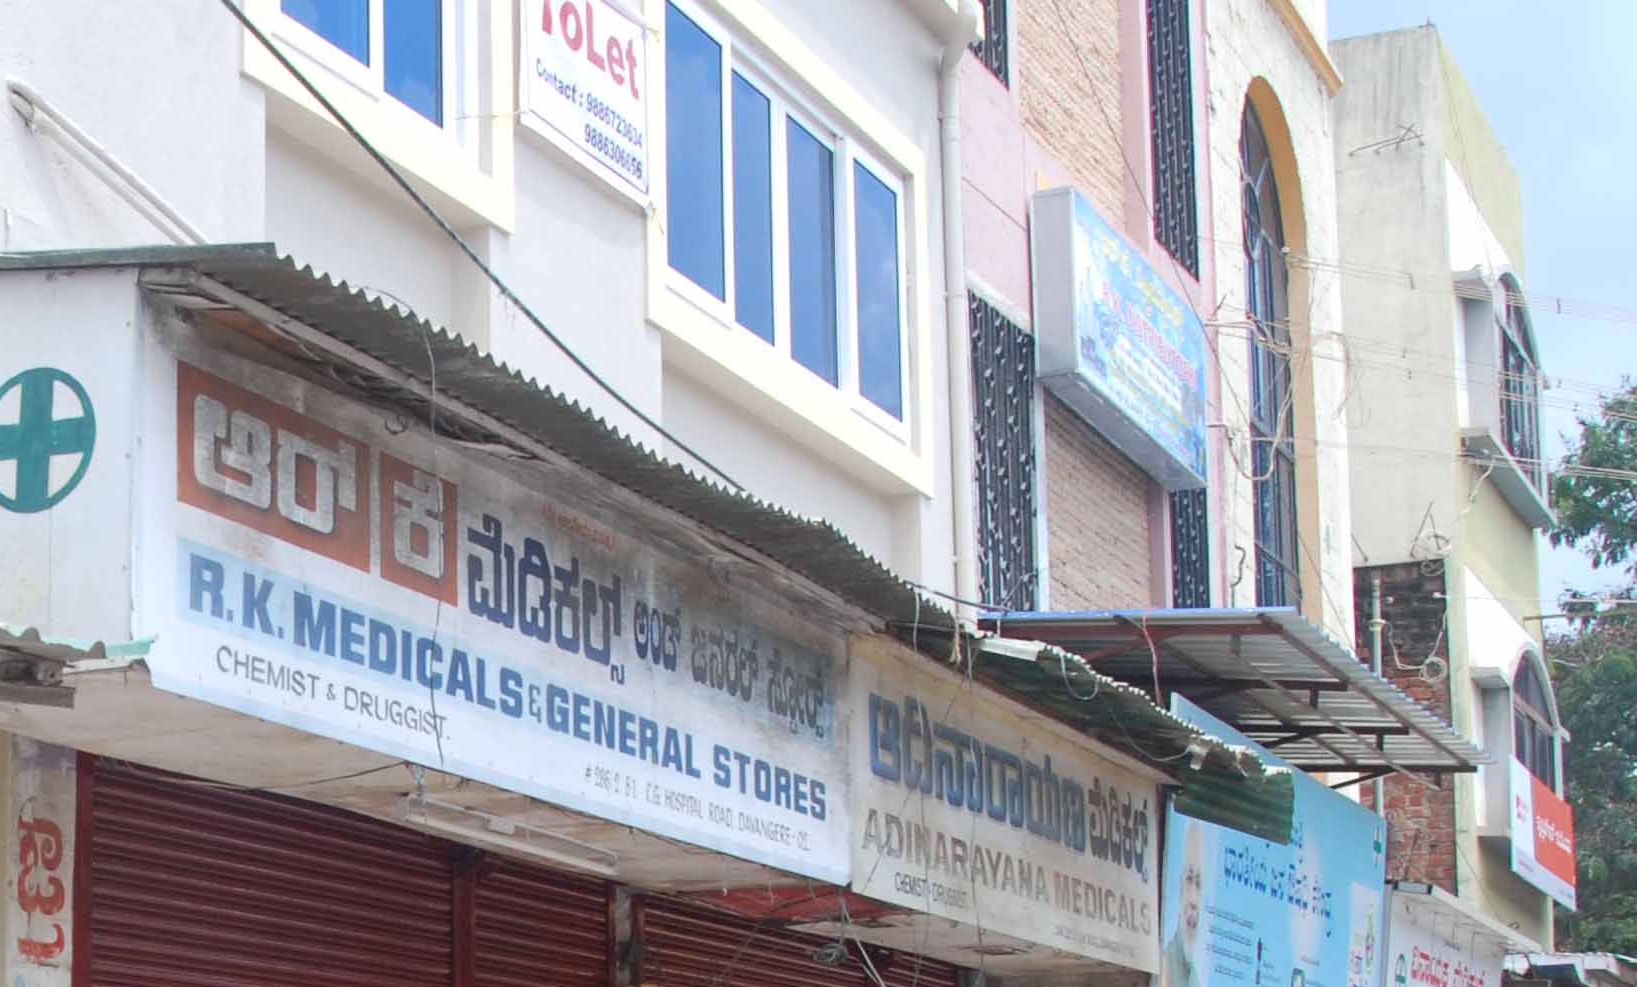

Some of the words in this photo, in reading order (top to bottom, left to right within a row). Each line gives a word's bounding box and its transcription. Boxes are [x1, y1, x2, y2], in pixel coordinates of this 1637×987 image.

[536, 58, 576, 103] Contact
[190, 553, 284, 639] R.K.
[293, 591, 522, 718] MEDICALS
[528, 683, 543, 724] &
[546, 683, 702, 780] GENERAL
[713, 743, 827, 822] STORES
[216, 645, 320, 700] CHEMIST
[326, 682, 336, 701] &
[344, 686, 451, 741] DRUGGIST.
[664, 790, 704, 820] HOSPITAL
[862, 808, 1050, 904] ADINARAYANA
[1053, 870, 1151, 937] MEDICALS
